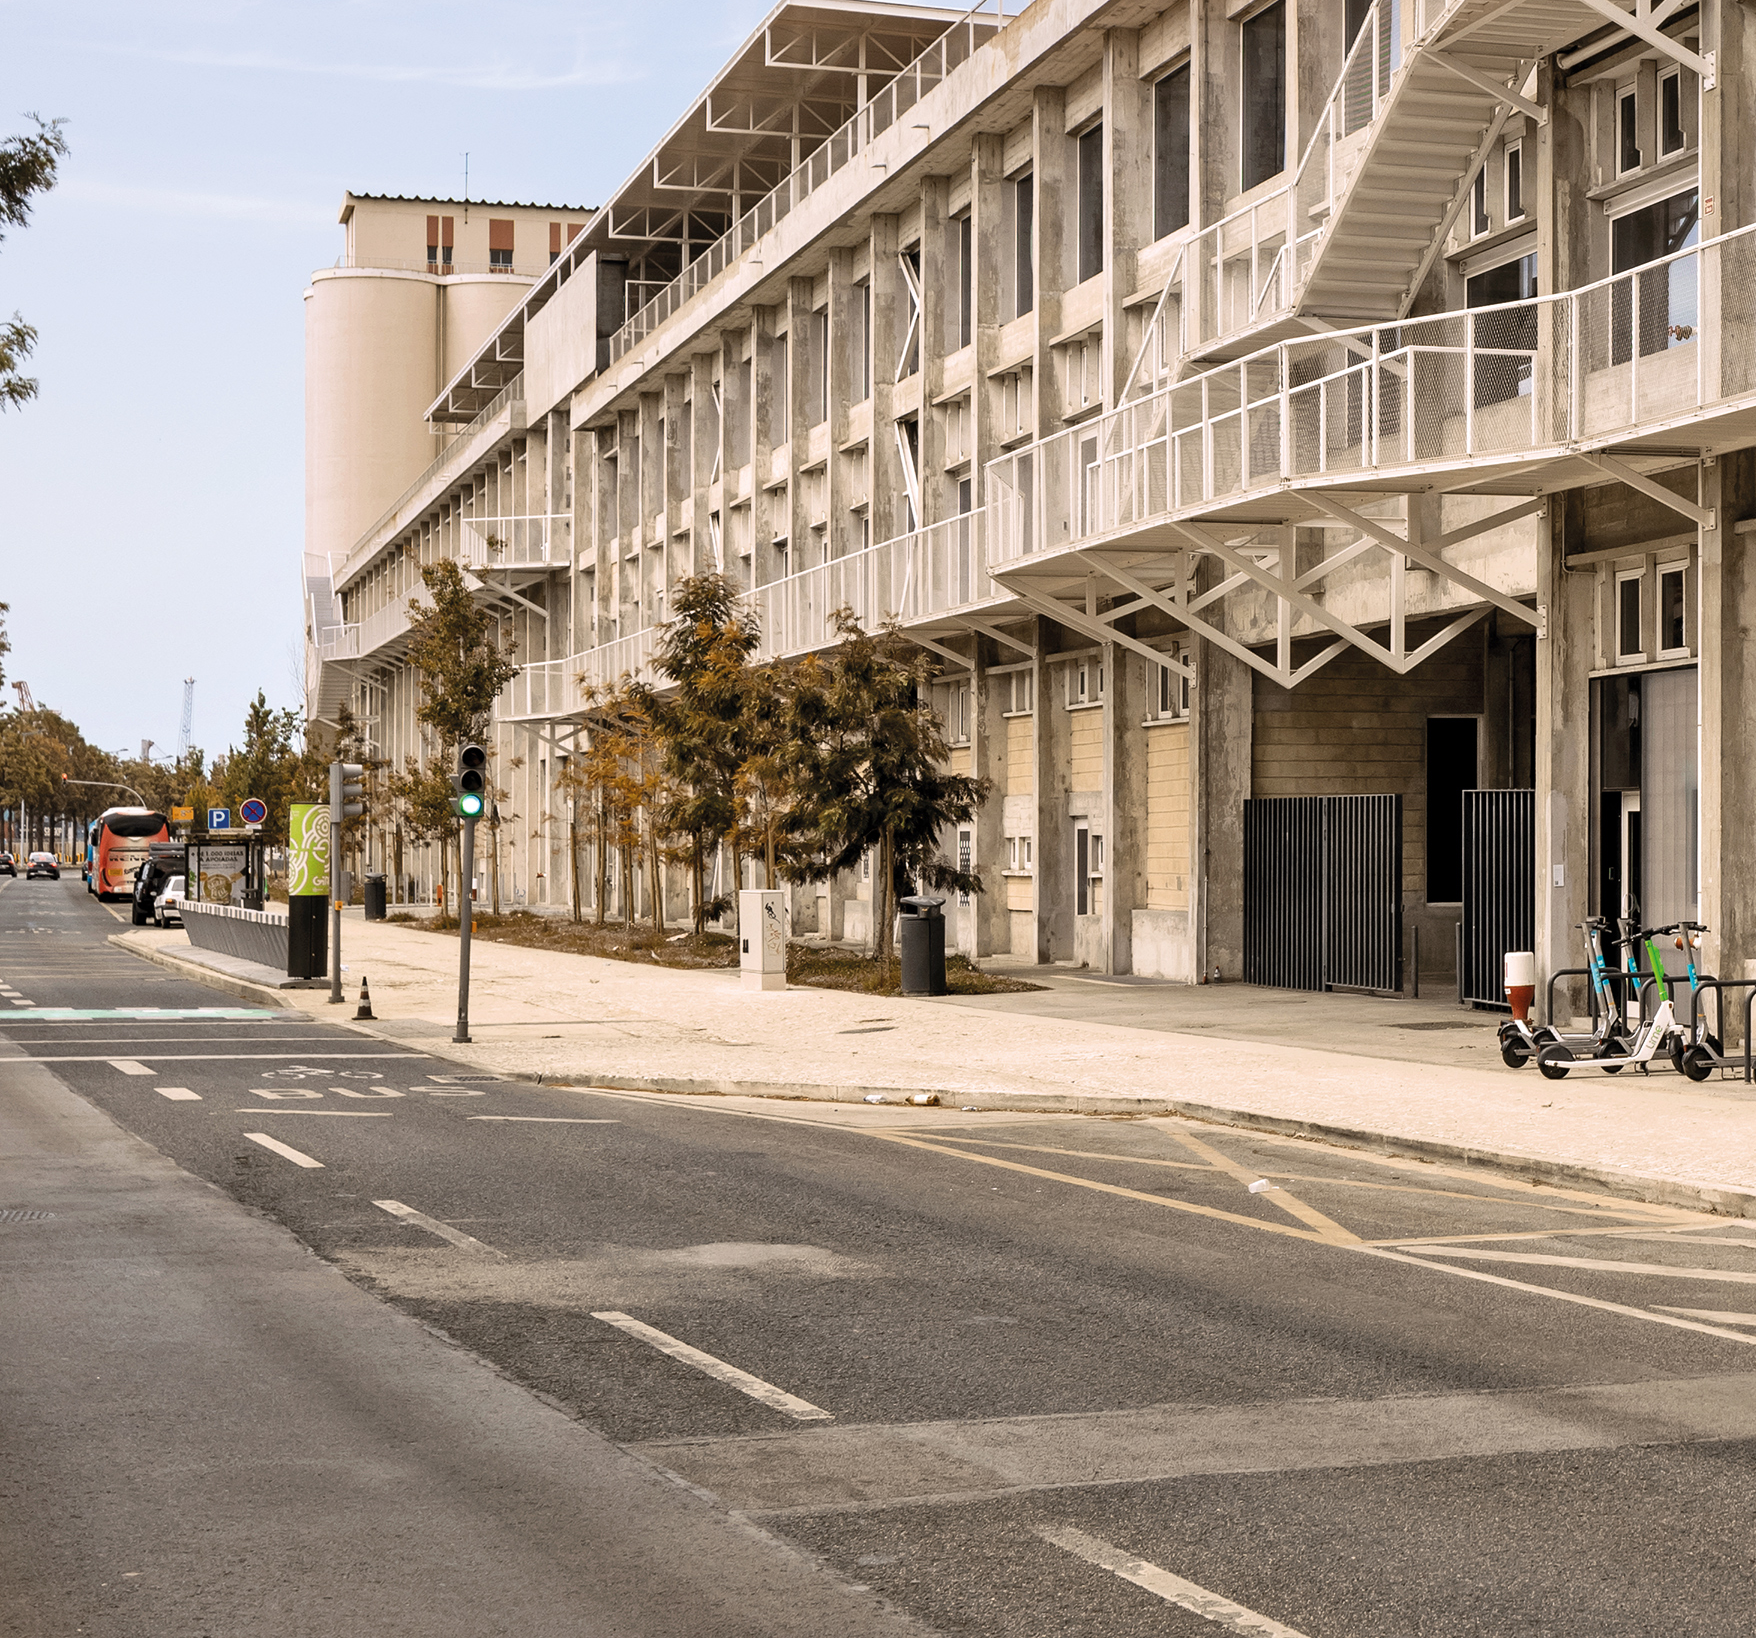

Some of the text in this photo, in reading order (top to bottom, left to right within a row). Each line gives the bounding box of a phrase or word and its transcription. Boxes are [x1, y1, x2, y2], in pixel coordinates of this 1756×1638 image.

[213, 811, 226, 827] P
[1646, 1024, 1663, 1050] Lime
[249, 1086, 486, 1099] BUS
